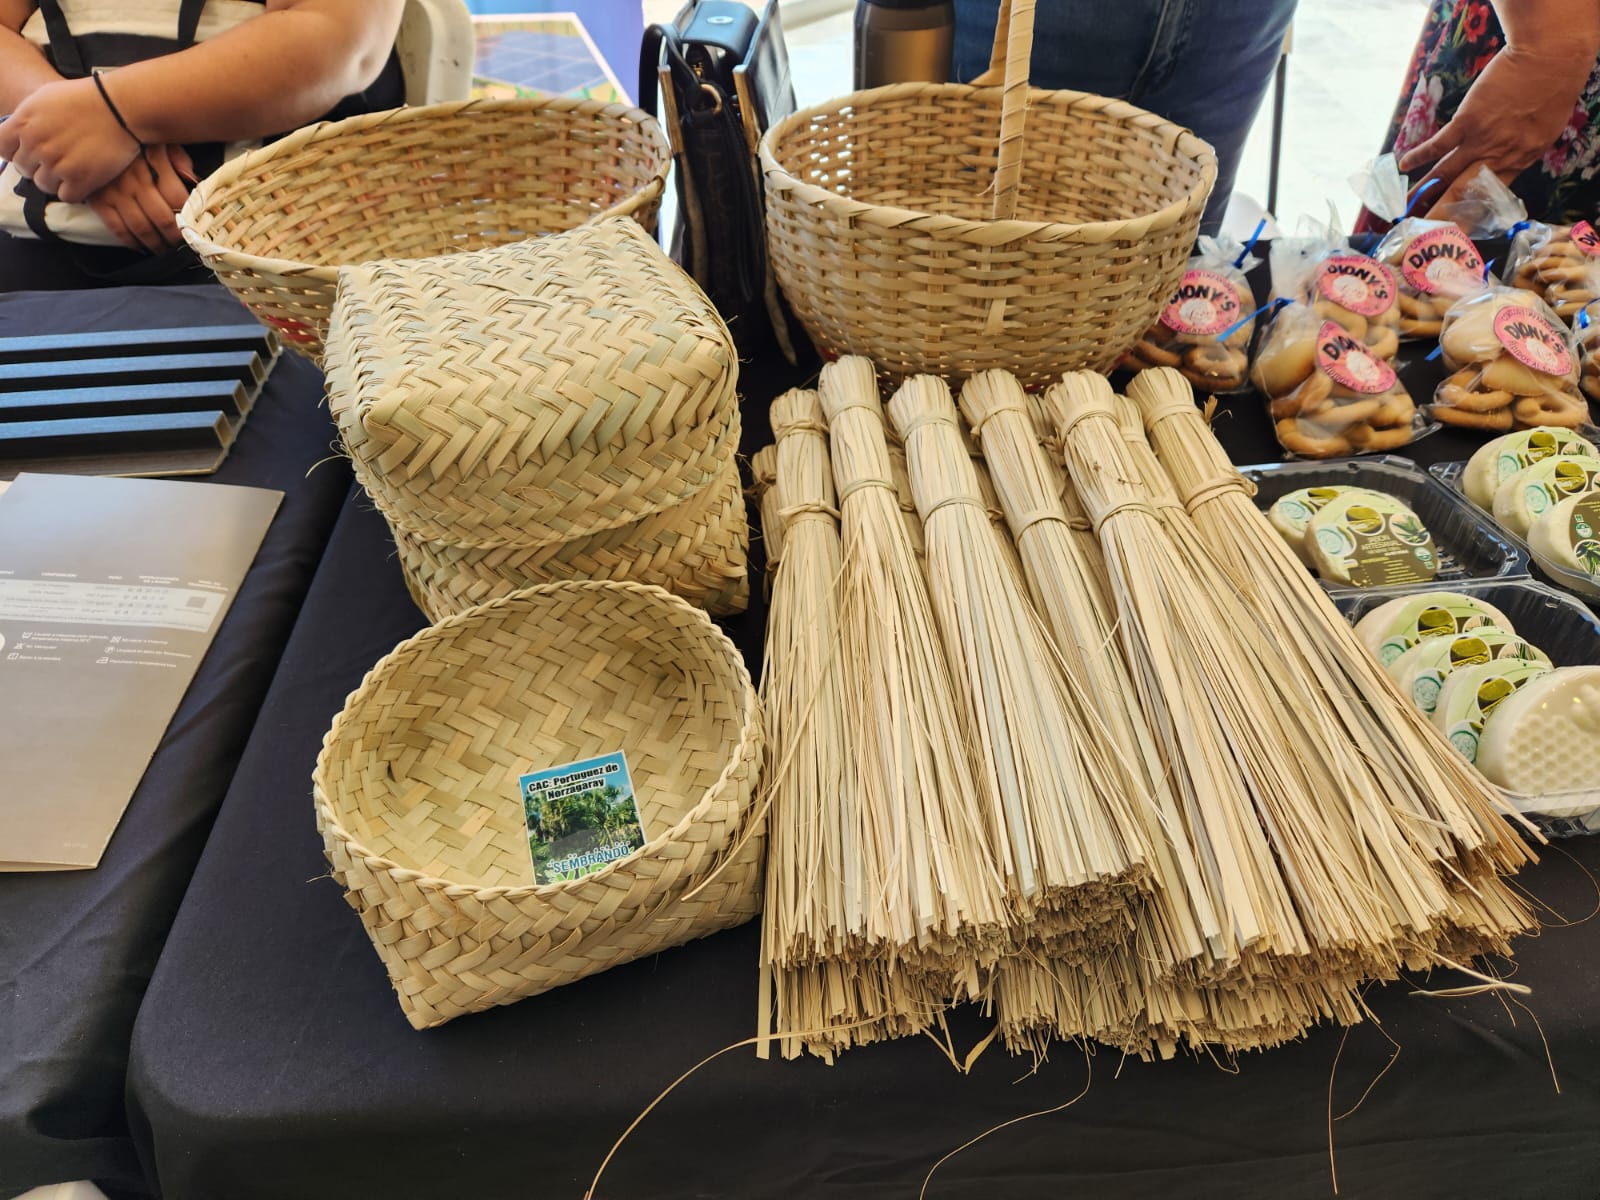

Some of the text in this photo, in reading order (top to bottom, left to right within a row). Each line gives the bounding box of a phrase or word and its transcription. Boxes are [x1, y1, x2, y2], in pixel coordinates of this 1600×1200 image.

[1408, 243, 1480, 269] DIONY'S
[1504, 321, 1564, 353] DIONY'S
[553, 767, 604, 786] Portuguez
[605, 763, 618, 773] de
[547, 778, 604, 799] Norzagaray
[553, 845, 629, 873] SEMBRANDO
